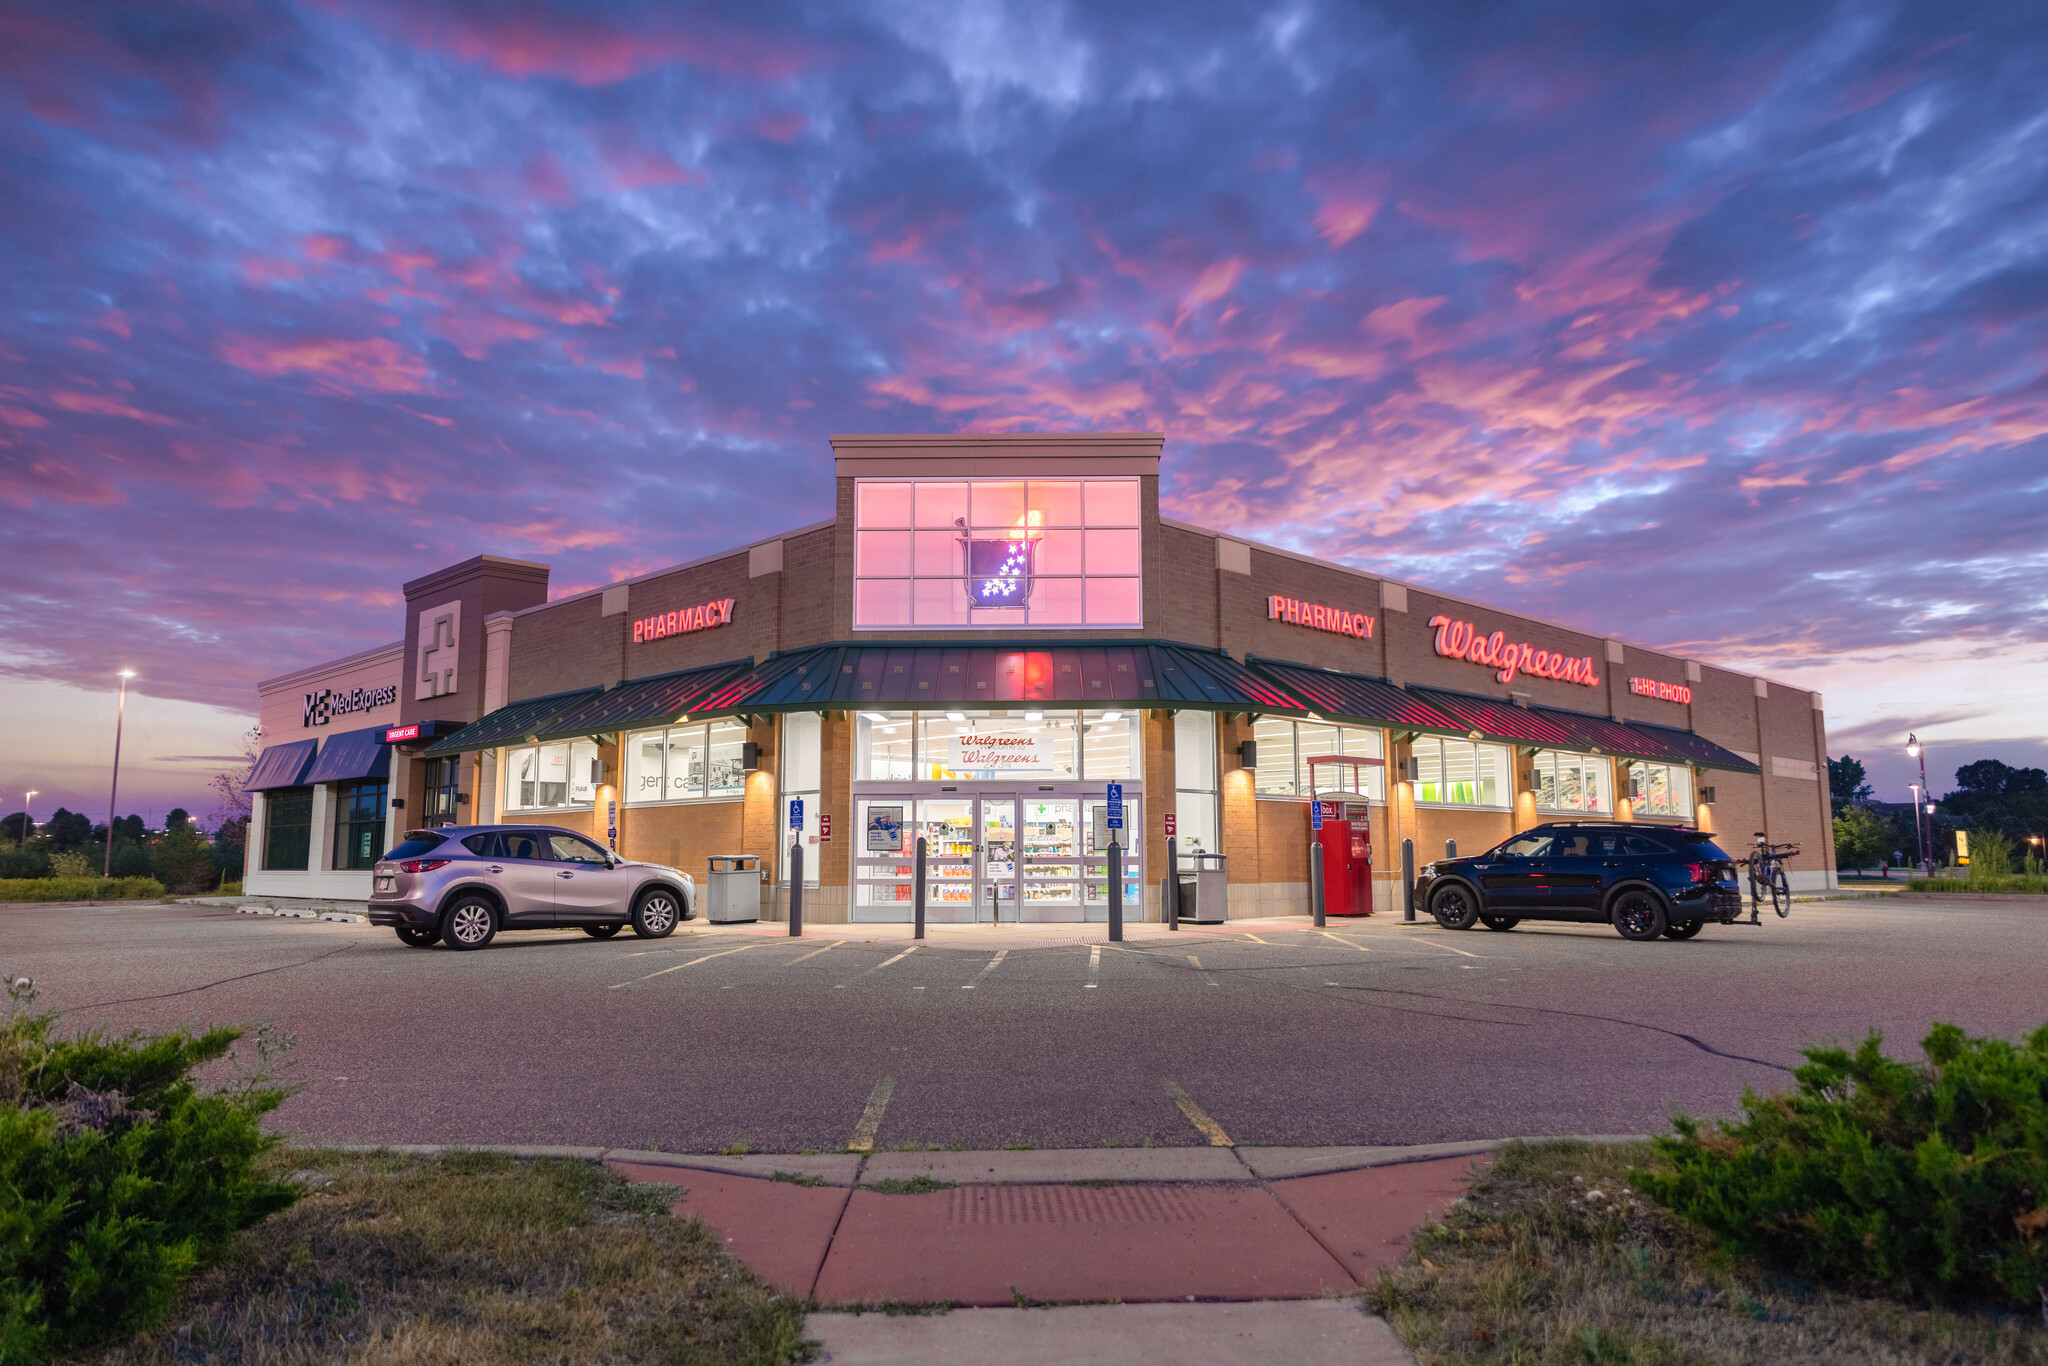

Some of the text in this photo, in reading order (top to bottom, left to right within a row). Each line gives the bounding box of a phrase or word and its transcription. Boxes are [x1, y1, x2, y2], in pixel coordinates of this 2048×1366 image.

[633, 598, 734, 643] PHARMACY
[1268, 594, 1375, 639] PHARMACY
[1429, 614, 1600, 687] Walgreens
[330, 685, 397, 715] MedExpress
[1629, 676, 1692, 705] 1-HR PHOTO
[388, 728, 416, 739] URGENT CARE
[959, 735, 1035, 749] Walgreens
[961, 749, 1040, 767] Walgreens
[575, 785, 588, 793] Pickup
